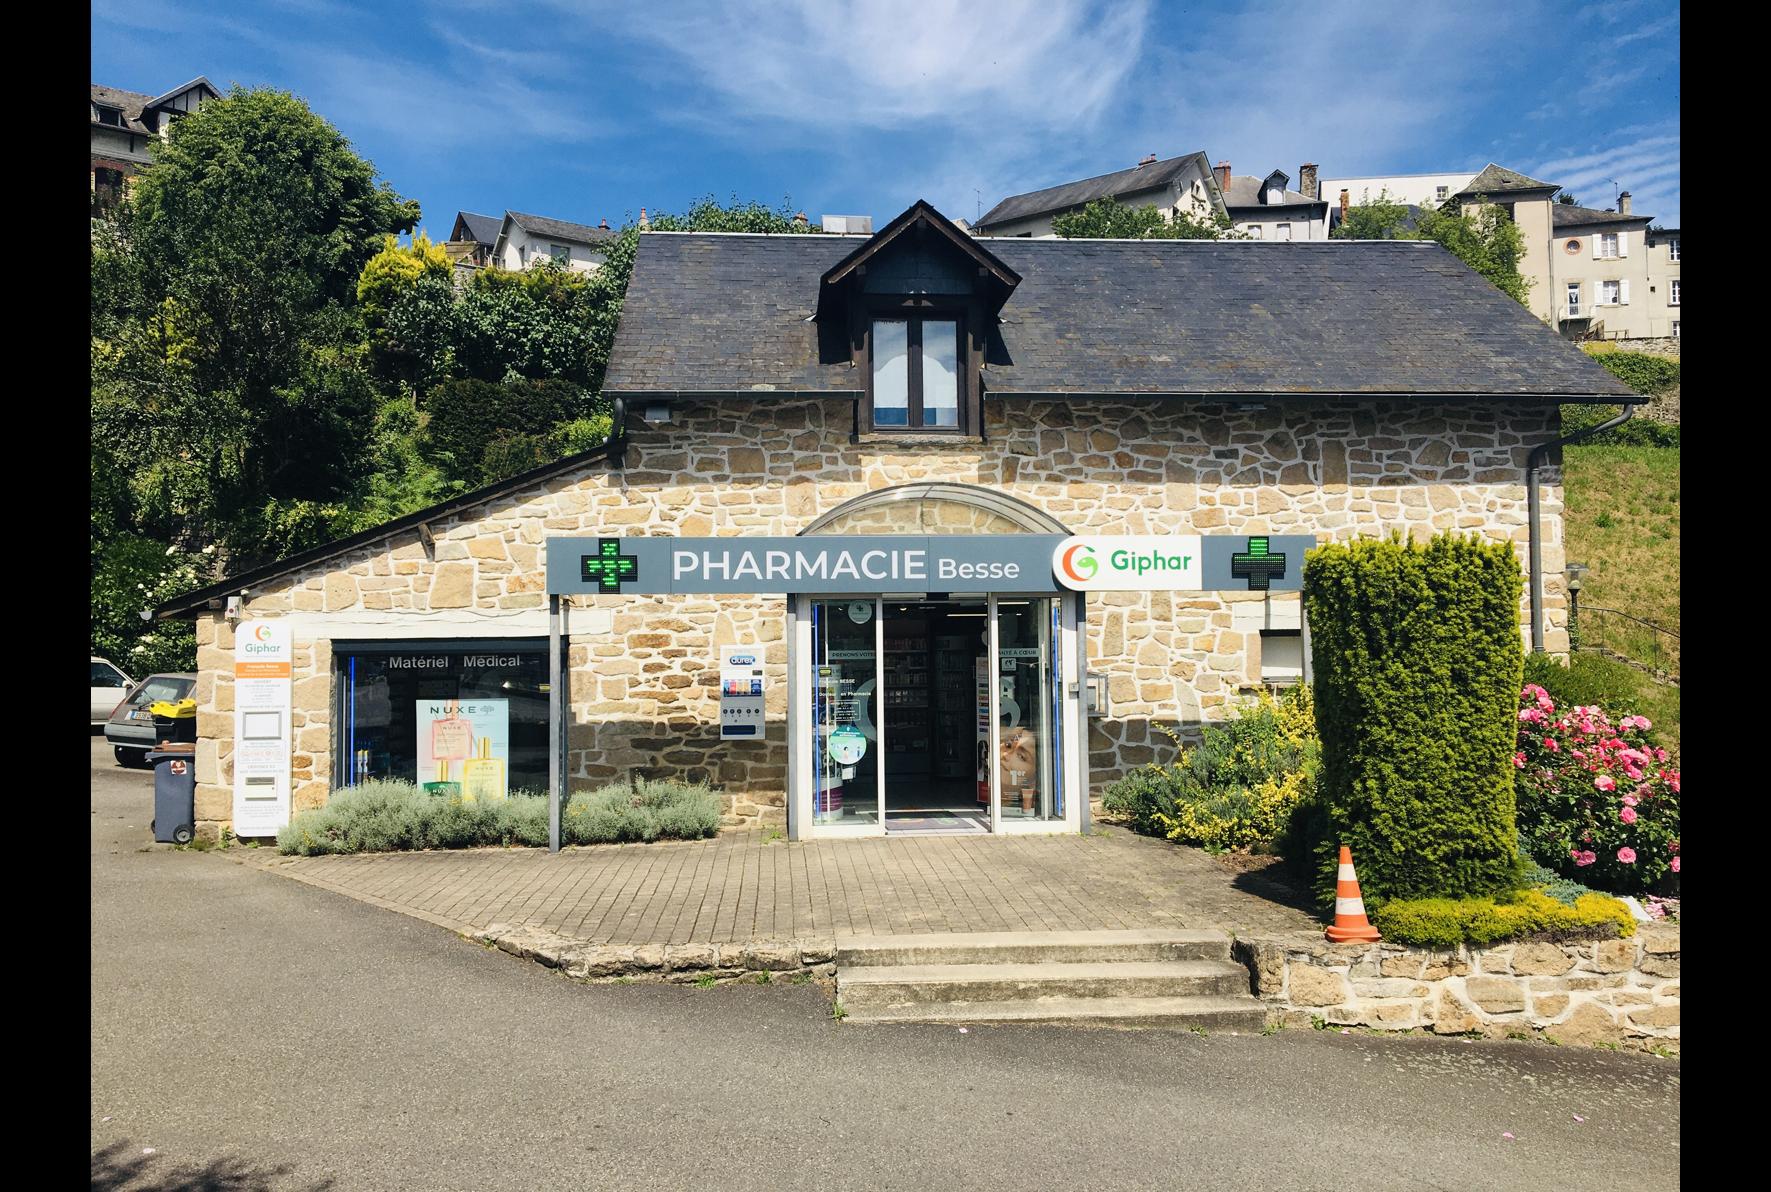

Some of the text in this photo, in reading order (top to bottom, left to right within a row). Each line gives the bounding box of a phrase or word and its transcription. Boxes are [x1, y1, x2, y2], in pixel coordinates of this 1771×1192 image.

[673, 550, 1020, 581] PHARMACIE Besse
[1111, 549, 1192, 576] Giphar
[245, 643, 281, 654] Giphar
[389, 655, 520, 669] Matériel Médical
[731, 656, 754, 664] durex
[430, 706, 477, 714] NUXE
